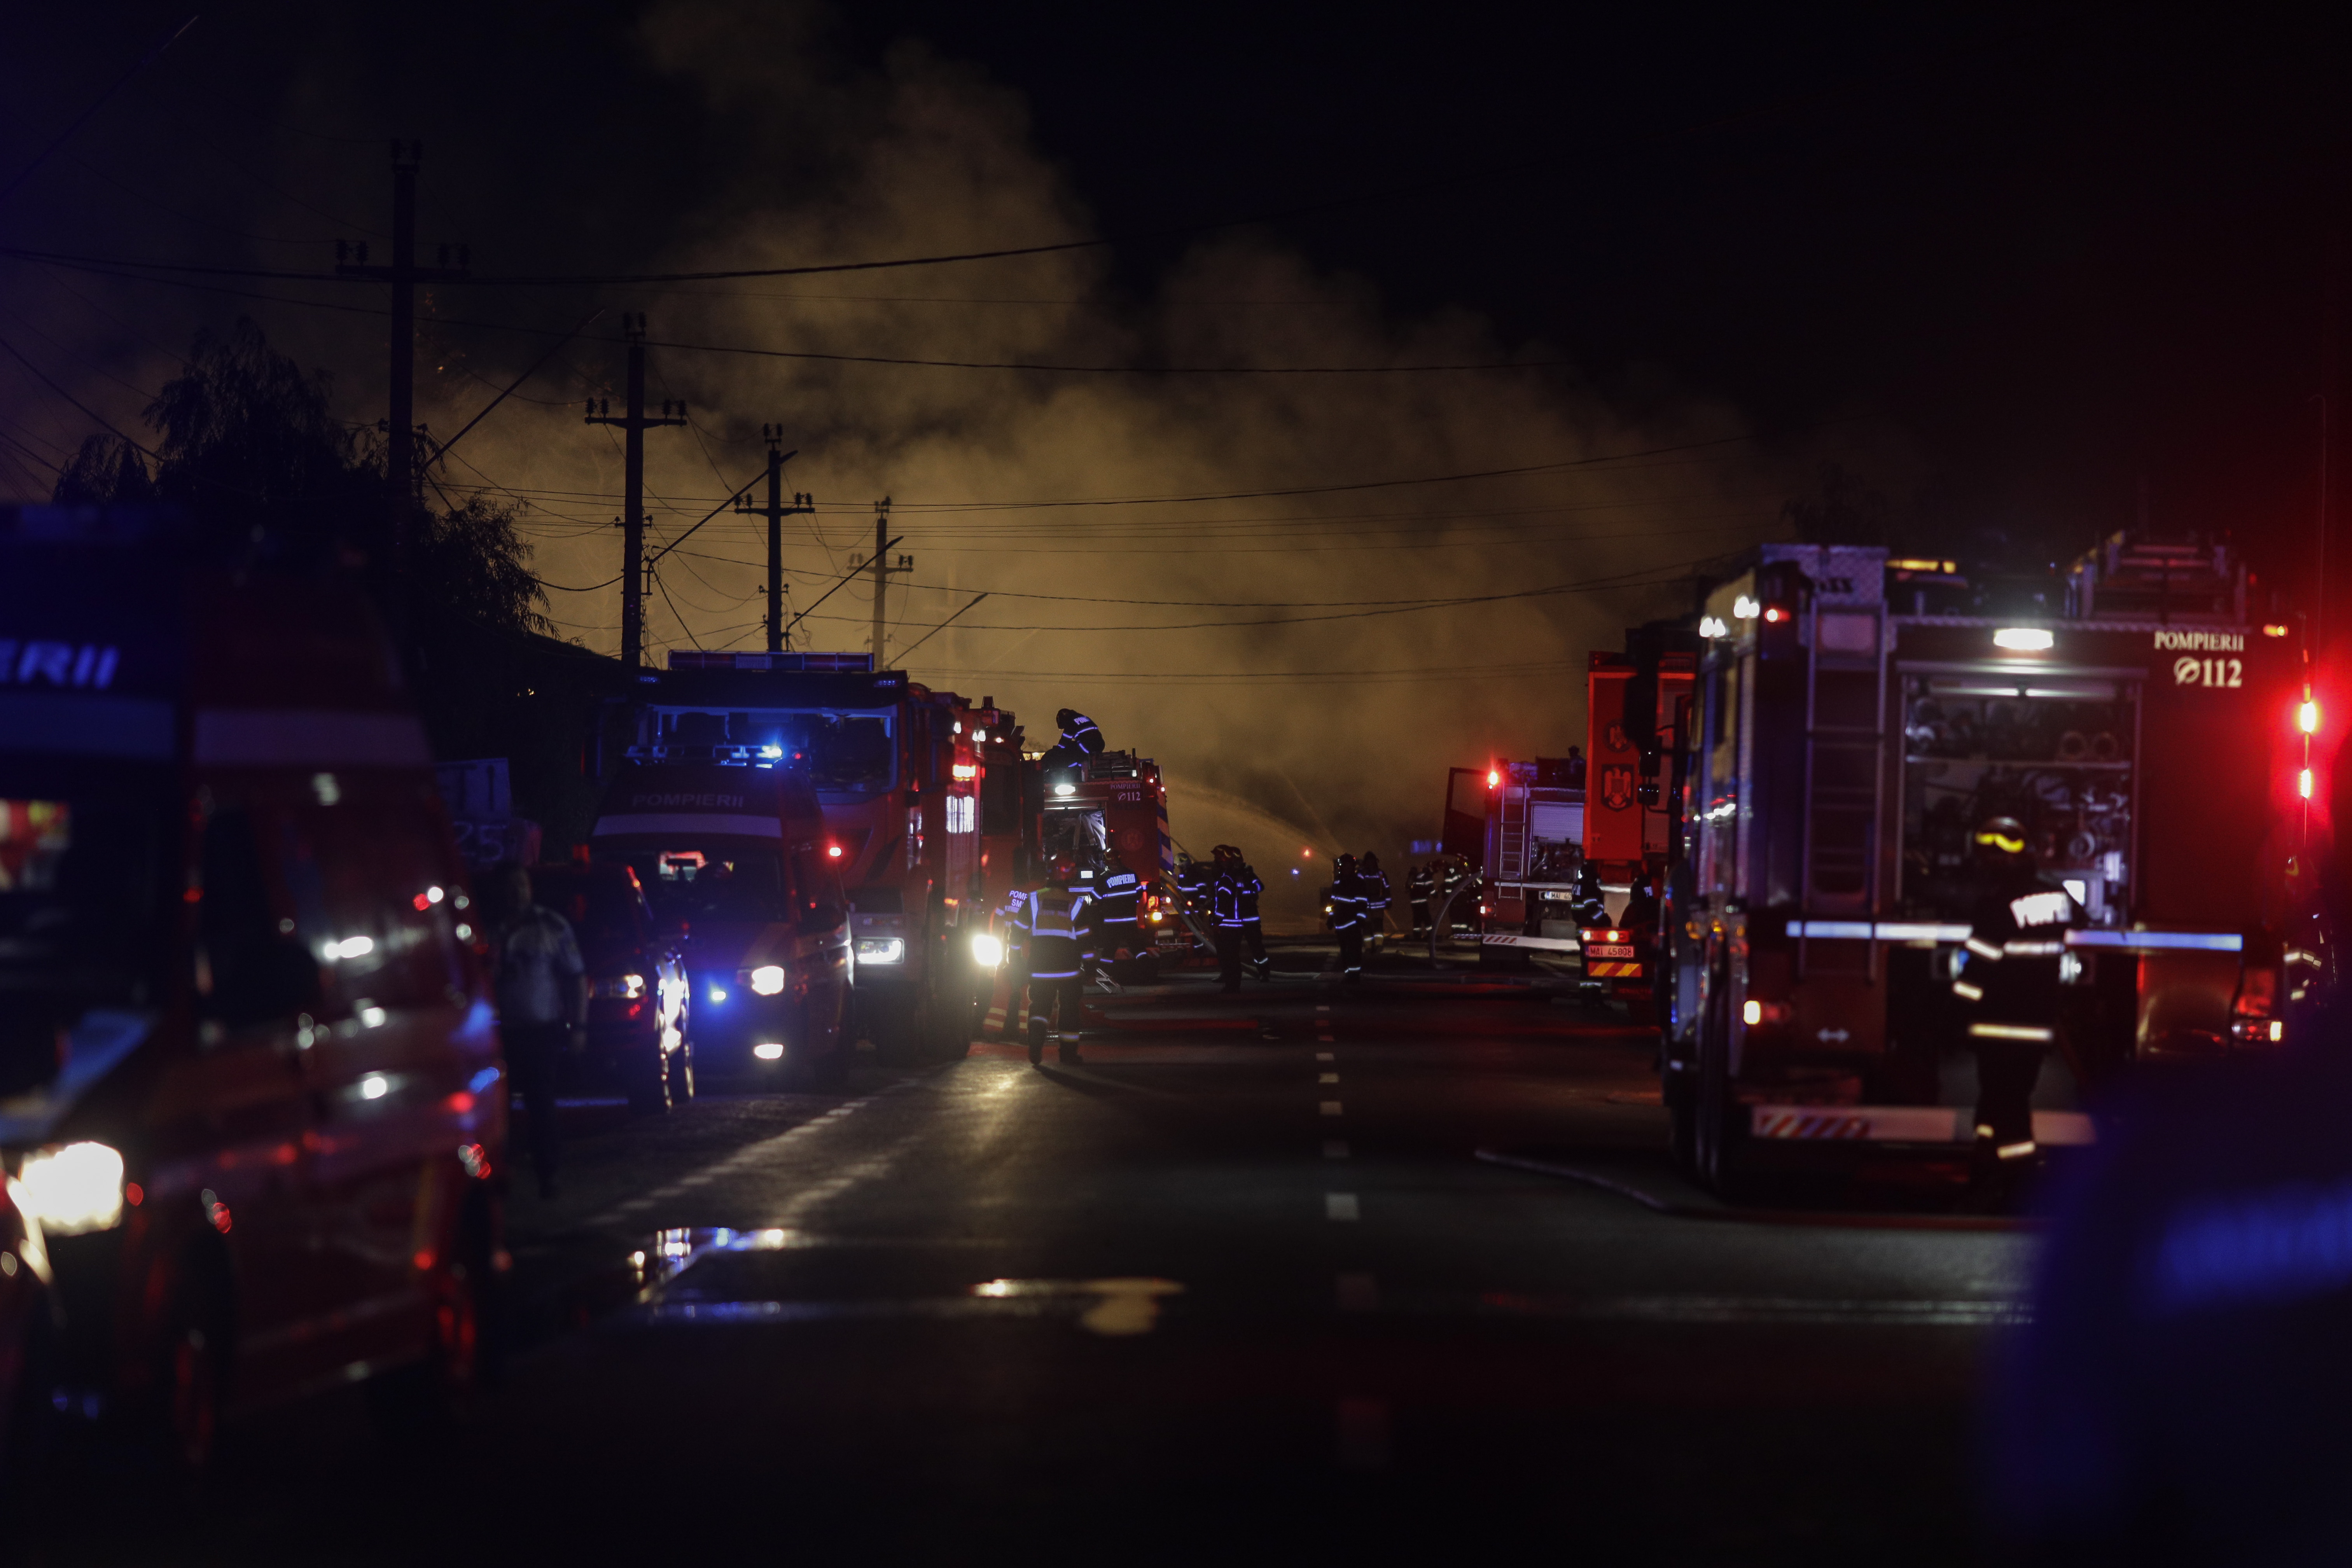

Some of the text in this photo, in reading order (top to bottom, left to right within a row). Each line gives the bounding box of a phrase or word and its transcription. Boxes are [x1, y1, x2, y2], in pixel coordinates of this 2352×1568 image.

[2154, 631, 2244, 652] POMPIERII
[2202, 658, 2242, 688] 112
[632, 794, 743, 807] POMPIERII
[1128, 792, 1141, 801] 112
[1107, 874, 1135, 888] POMPIERII
[1590, 947, 1603, 956] MAI
